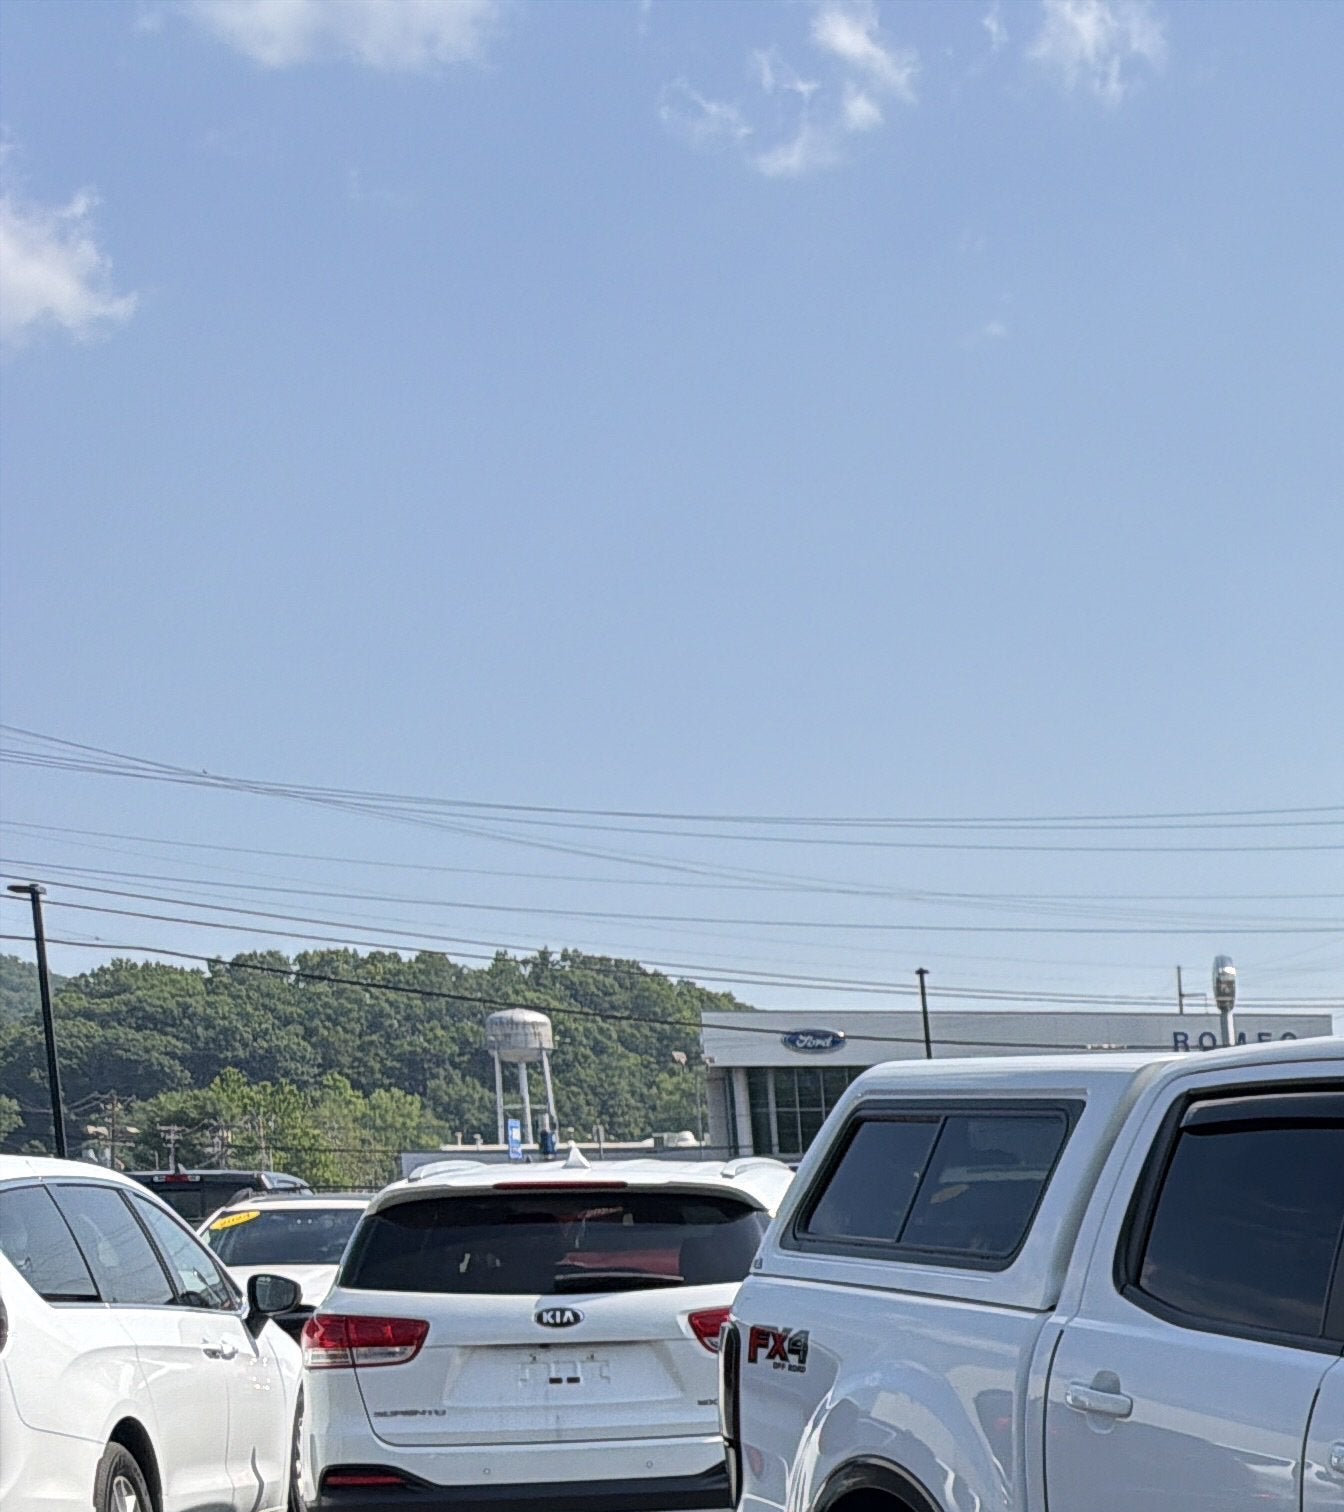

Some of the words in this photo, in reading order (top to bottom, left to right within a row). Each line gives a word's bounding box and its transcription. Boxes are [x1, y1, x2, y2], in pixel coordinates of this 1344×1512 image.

[796, 1034, 833, 1048] Ford
[542, 1310, 575, 1324] KIA
[748, 1325, 810, 1365] FX4
